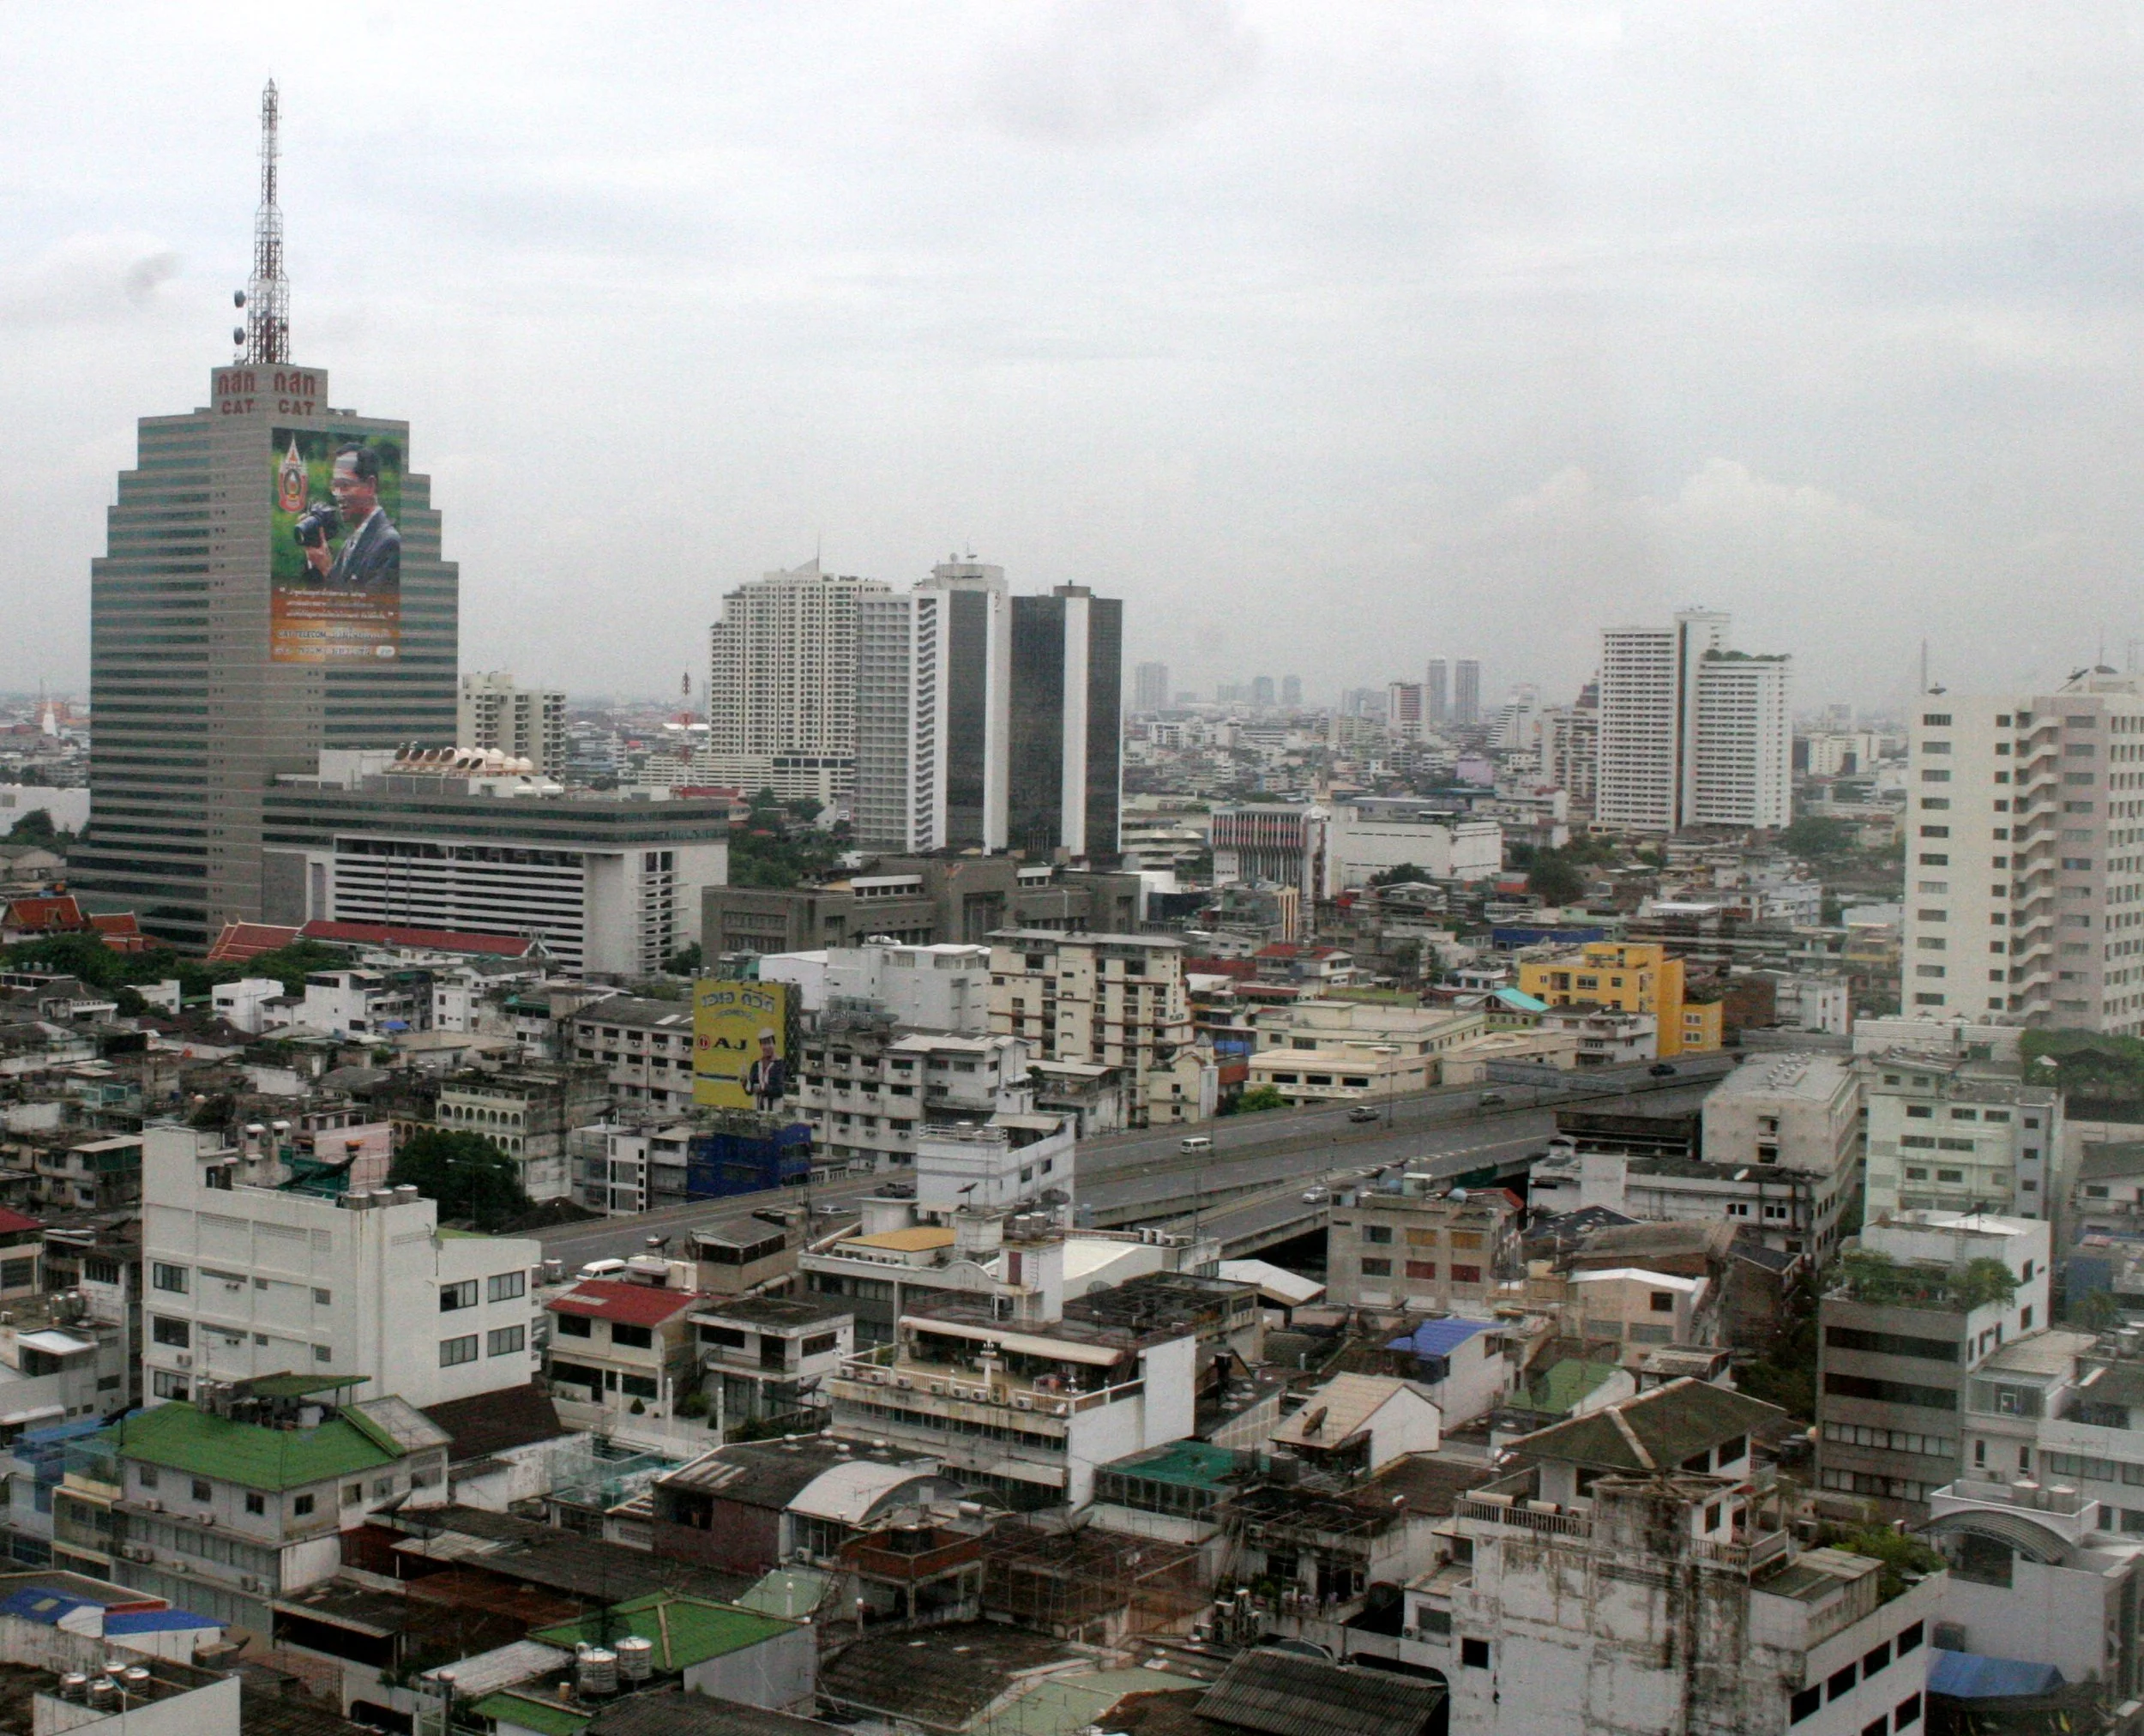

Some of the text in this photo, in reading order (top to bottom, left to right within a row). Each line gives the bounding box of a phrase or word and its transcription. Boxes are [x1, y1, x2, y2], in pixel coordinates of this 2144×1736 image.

[218, 371, 256, 395] กสท
[274, 371, 316, 396] กสท
[222, 398, 255, 415] CAT
[278, 398, 315, 416] CAT
[713, 1037, 747, 1050] AJ
